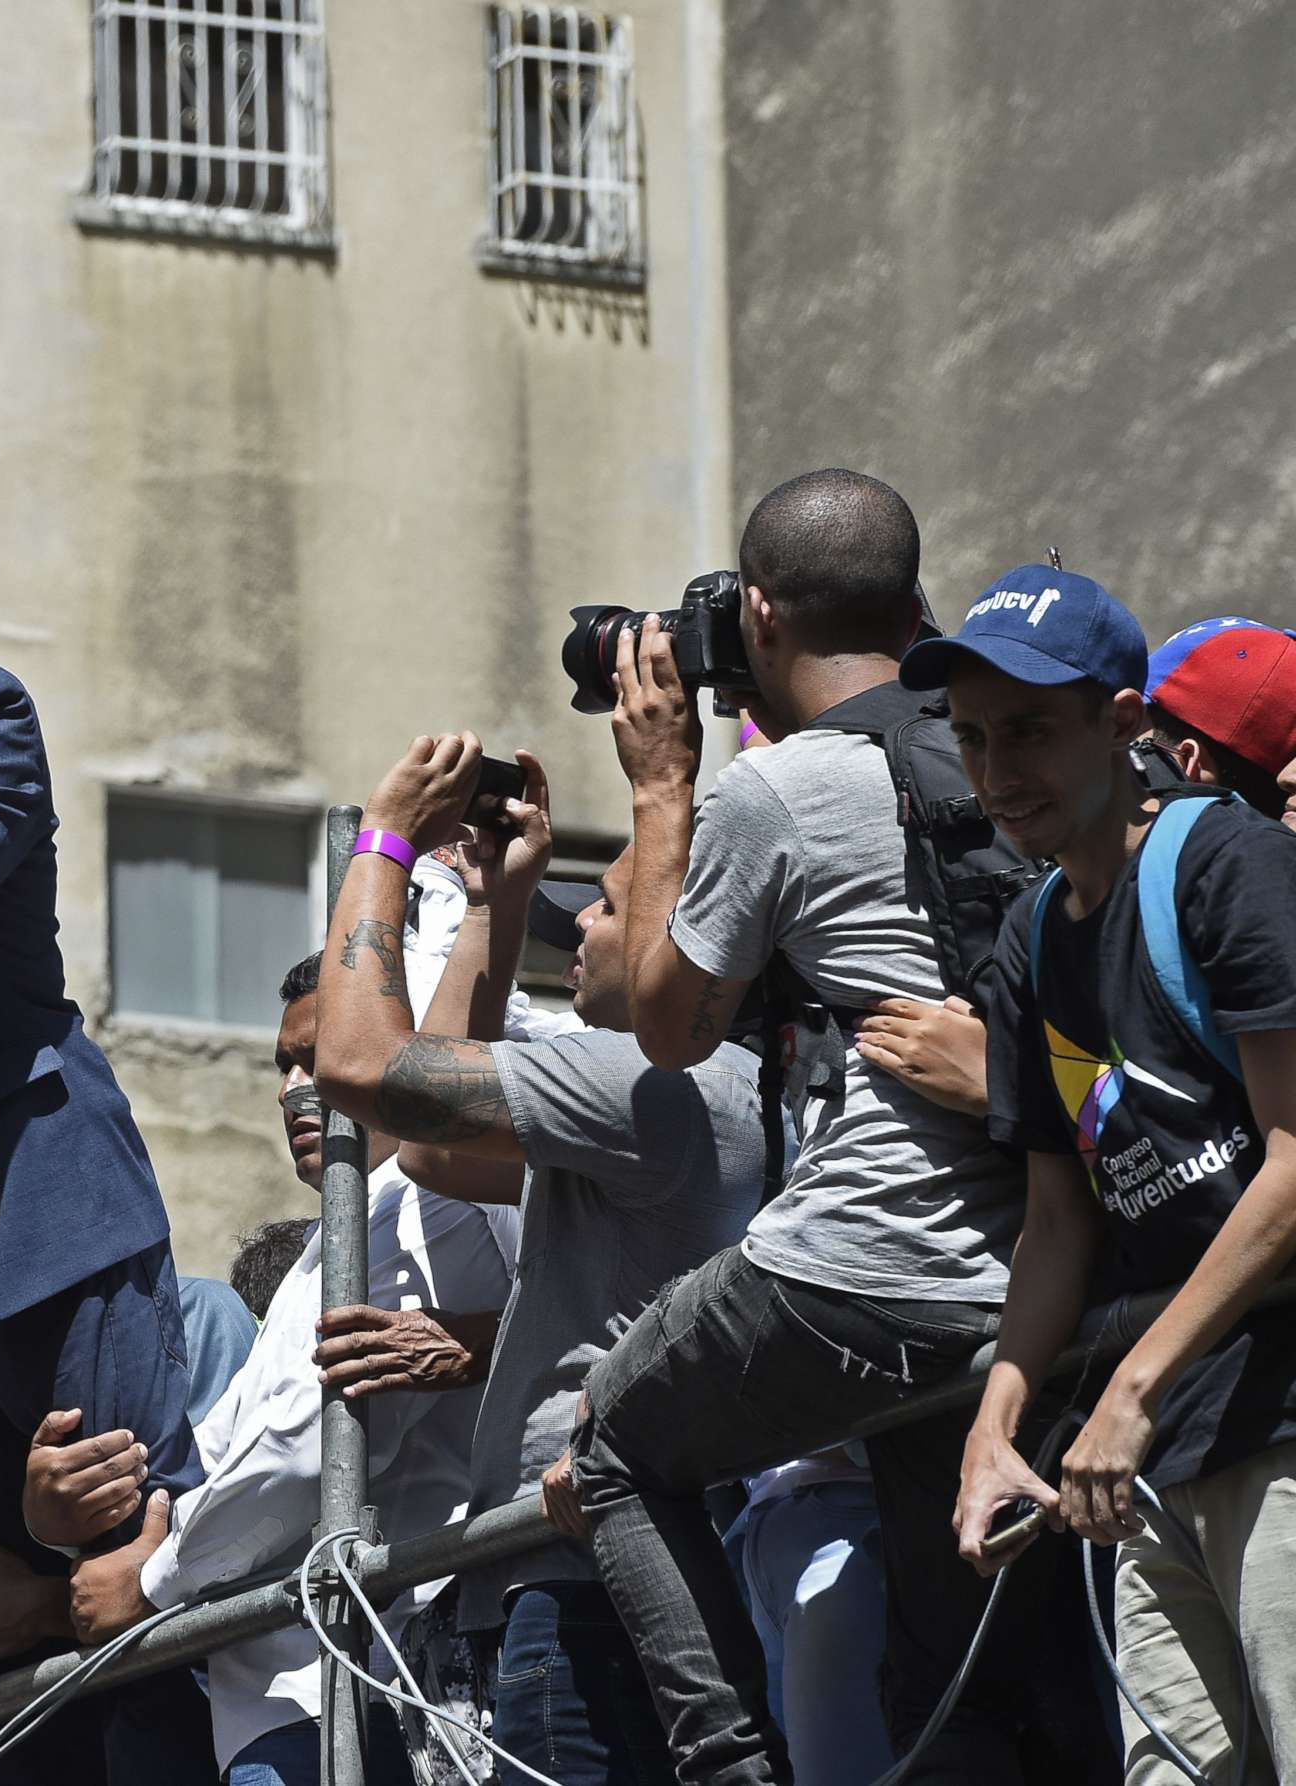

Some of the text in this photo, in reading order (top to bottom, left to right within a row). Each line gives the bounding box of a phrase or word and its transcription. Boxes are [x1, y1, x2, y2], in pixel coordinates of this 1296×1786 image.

[1102, 1137, 1152, 1175] Congreso
[1112, 1150, 1162, 1193] Nacional
[1113, 1125, 1250, 1225] Juventudes
